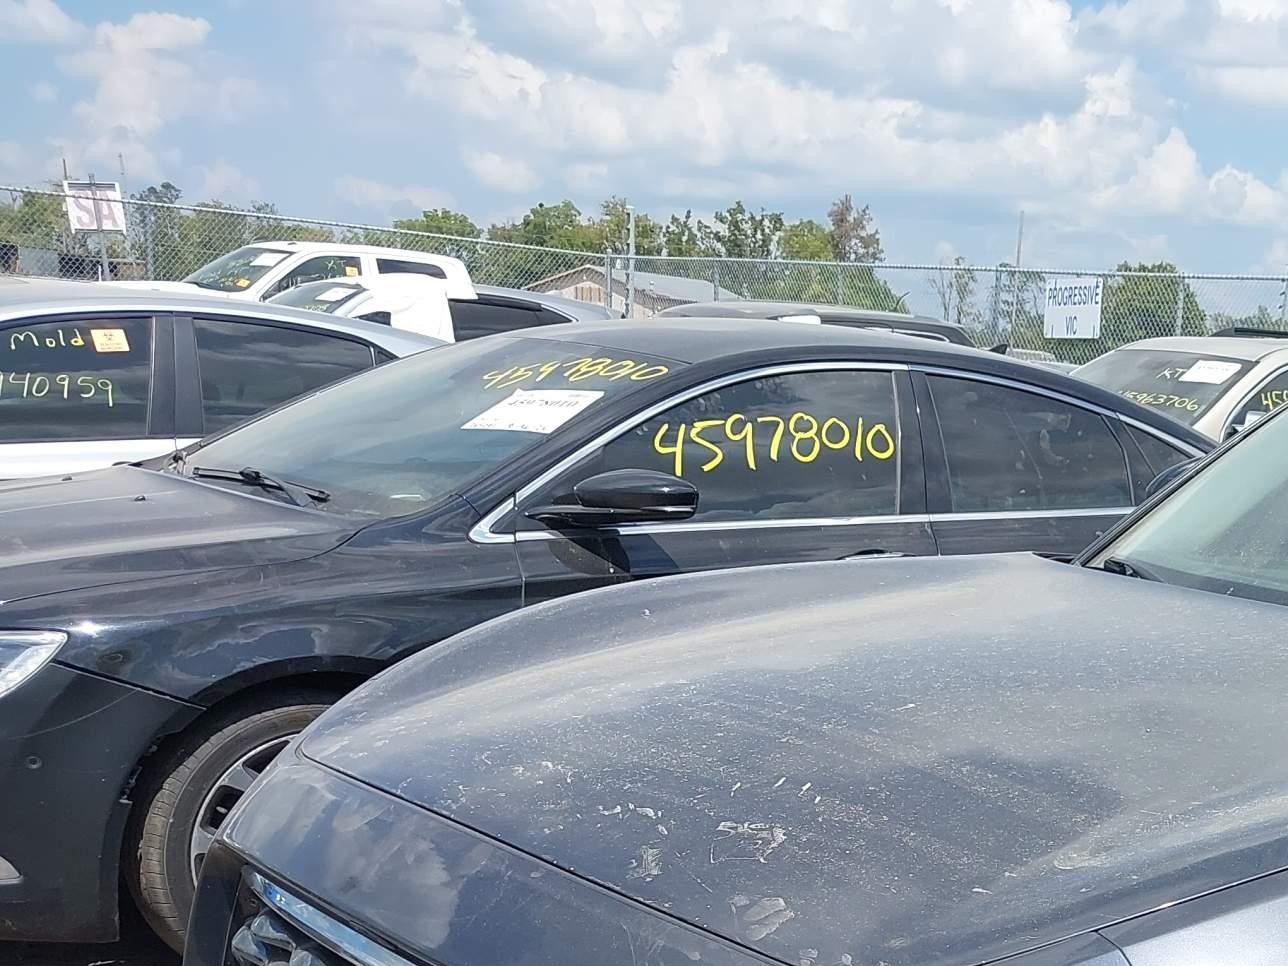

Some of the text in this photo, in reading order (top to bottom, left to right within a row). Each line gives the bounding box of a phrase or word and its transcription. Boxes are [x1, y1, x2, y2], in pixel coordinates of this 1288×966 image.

[1048, 285, 1100, 307] PROGRESSIVE
[1065, 315, 1078, 336] VIC
[10, 328, 85, 350] Mold
[0, 371, 114, 408] 40959
[652, 412, 896, 477] 45978010
